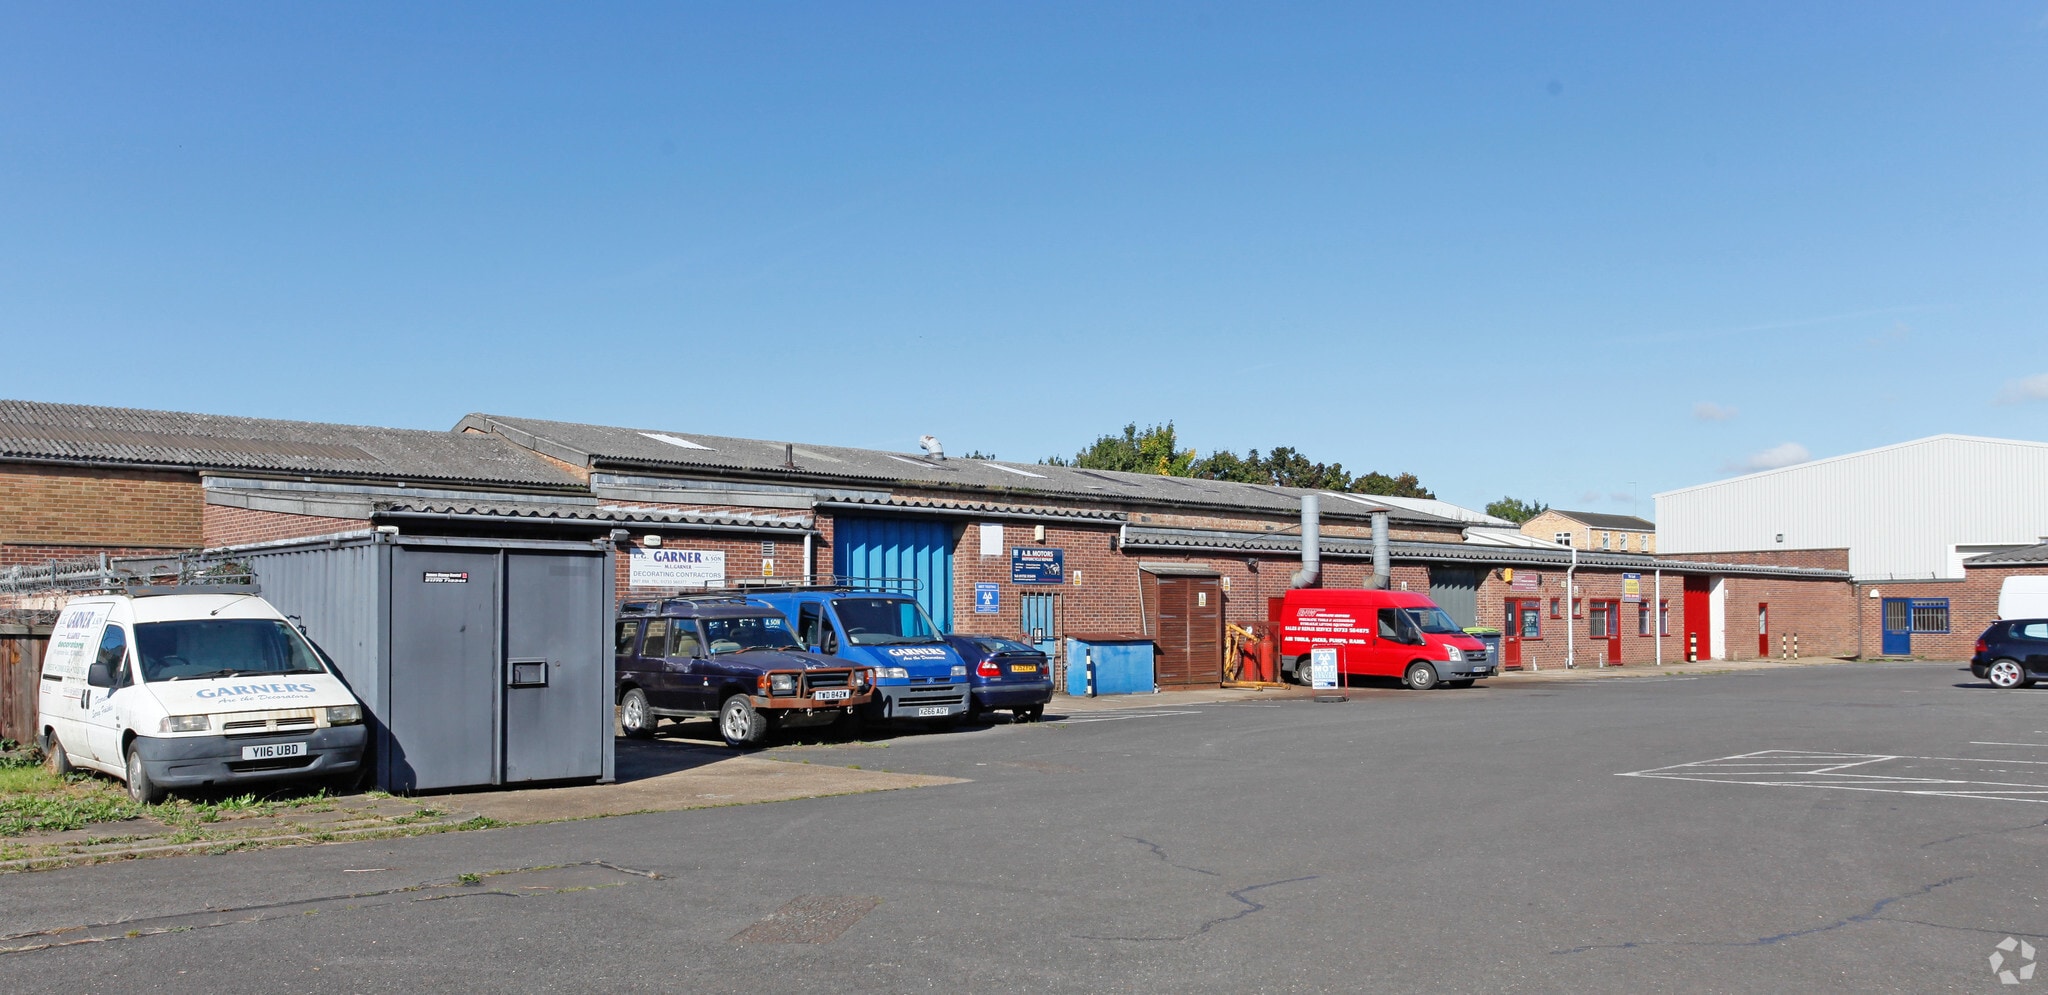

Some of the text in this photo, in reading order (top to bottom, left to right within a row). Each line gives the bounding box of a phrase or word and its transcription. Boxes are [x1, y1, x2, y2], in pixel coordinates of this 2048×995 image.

[653, 551, 702, 563] GARNER
[633, 570, 722, 579] DECORATING CONTRACTORS
[888, 648, 946, 656] GARNERS
[196, 683, 316, 699] GARNERS
[818, 691, 831, 699] TWD
[257, 693, 309, 701] Decorators
[936, 707, 948, 715] AGY
[252, 744, 299, 758] Y116 UBD
